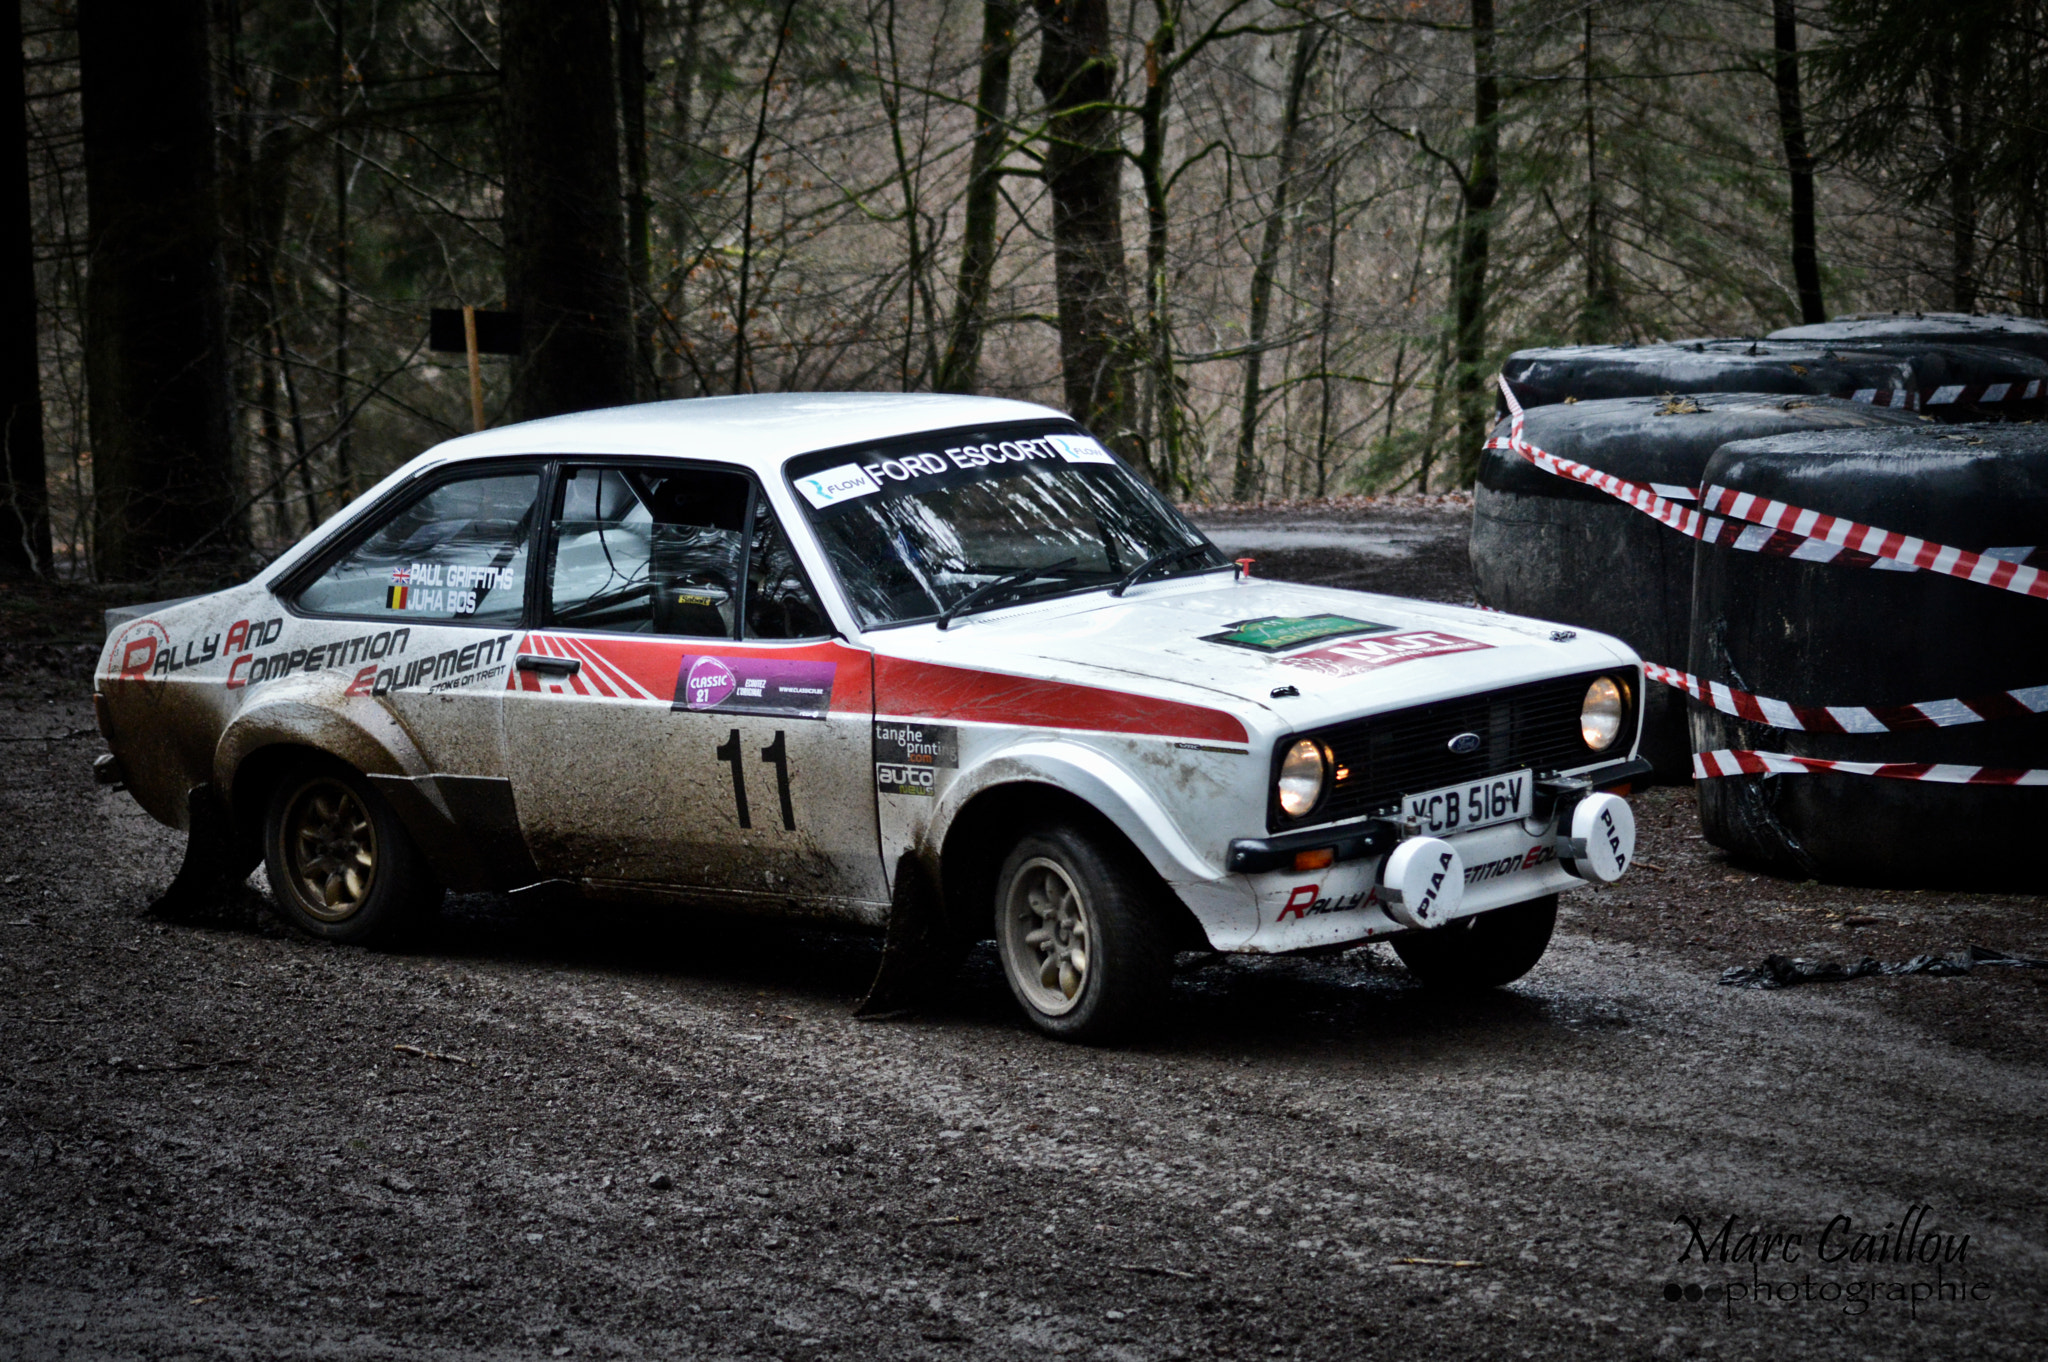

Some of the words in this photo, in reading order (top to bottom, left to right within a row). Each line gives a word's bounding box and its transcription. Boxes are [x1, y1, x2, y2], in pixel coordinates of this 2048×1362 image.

[863, 453, 948, 485] FORD
[944, 438, 1056, 469] ESCORT
[1073, 444, 1103, 456] FLOW
[827, 477, 866, 495] FLOW
[409, 563, 443, 586] PAUL
[446, 565, 514, 590] GRIFFITHS
[407, 589, 443, 612] JUHA
[446, 590, 477, 614] BOS
[223, 617, 283, 656] AND
[118, 632, 221, 690] RALLY
[226, 627, 411, 690] COMPETITION
[344, 633, 513, 697] EQUIPMENT
[427, 676, 460, 695] STOKE
[461, 674, 474, 686] ON
[476, 664, 506, 680] TRENT
[690, 675, 728, 689] CLASSIC
[696, 689, 709, 702] 21
[876, 724, 923, 747] tanghe
[906, 741, 958, 762] printing
[908, 754, 933, 763] .com
[716, 728, 796, 831] 11
[879, 766, 934, 786] auto
[1468, 777, 1523, 823] 516V
[1601, 808, 1626, 873] PIAA
[1416, 852, 1454, 920] PIAA
[1276, 884, 1367, 922] RALLY
